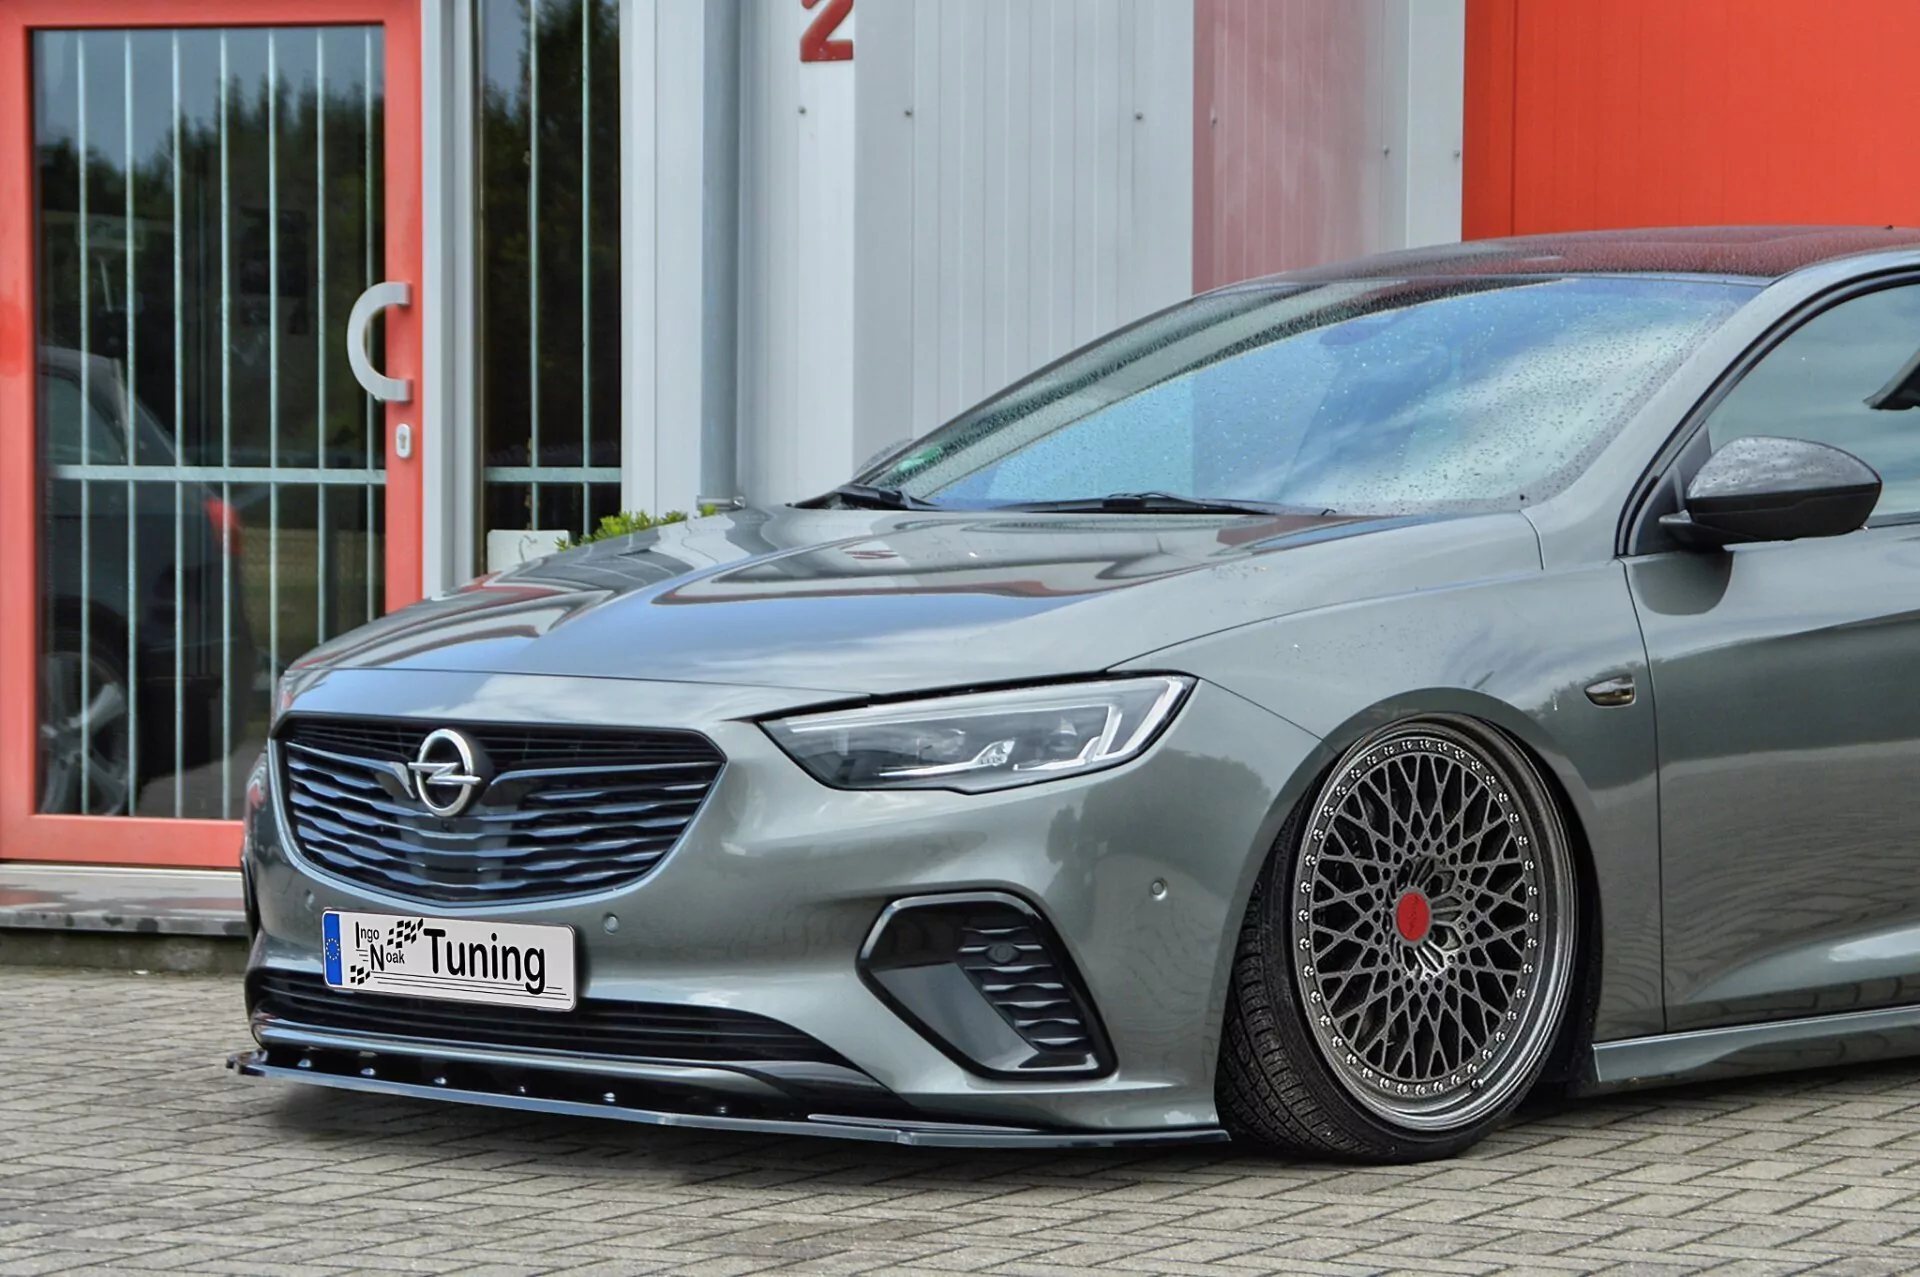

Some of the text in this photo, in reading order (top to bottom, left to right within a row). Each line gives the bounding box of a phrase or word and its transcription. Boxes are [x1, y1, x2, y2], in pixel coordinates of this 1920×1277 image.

[355, 921, 380, 948] Ingo
[370, 944, 405, 971] Noak
[423, 928, 545, 994] Tuning
